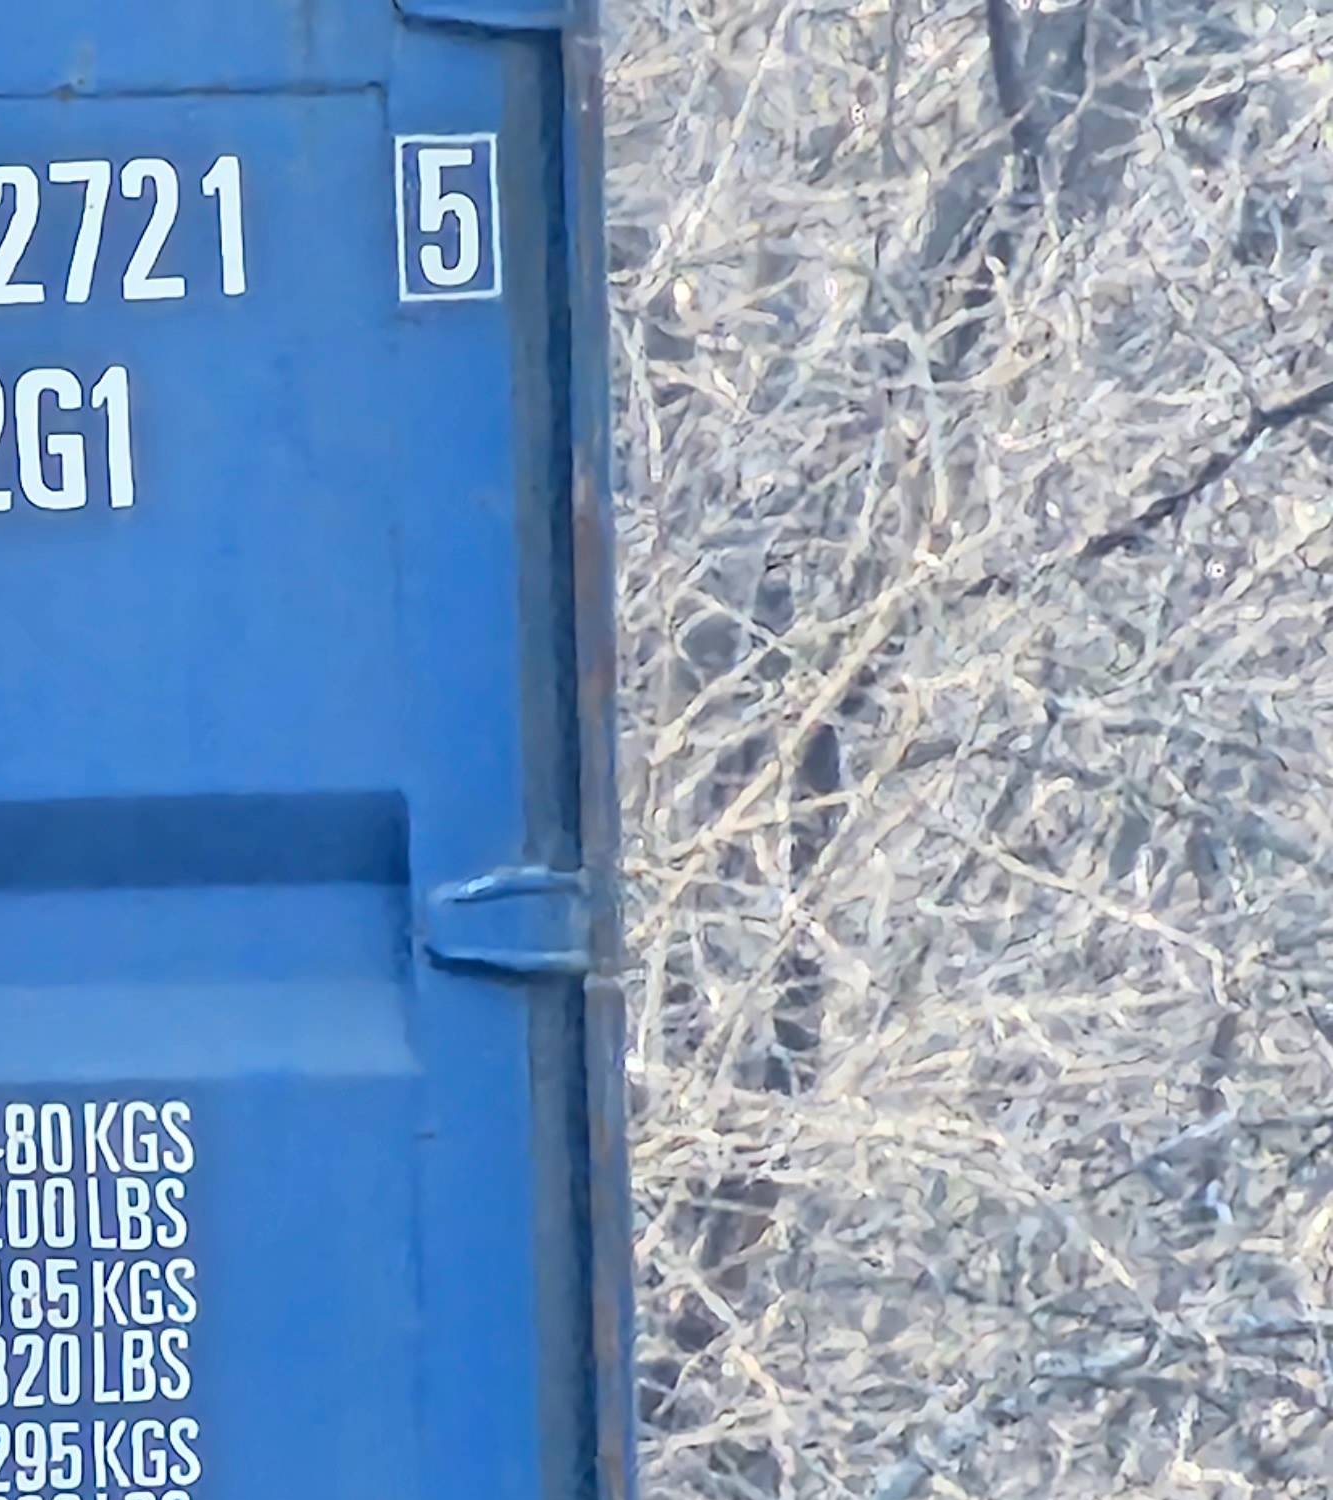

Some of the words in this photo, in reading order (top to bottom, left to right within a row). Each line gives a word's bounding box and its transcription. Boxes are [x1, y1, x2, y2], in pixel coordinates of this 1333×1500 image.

[417, 147, 480, 287] 5
[83, 1100, 195, 1175] KGS
[86, 1175, 188, 1251] LBS
[91, 1257, 198, 1329] KGS
[92, 1327, 192, 1404] LBS
[92, 1416, 202, 1489] KGS
